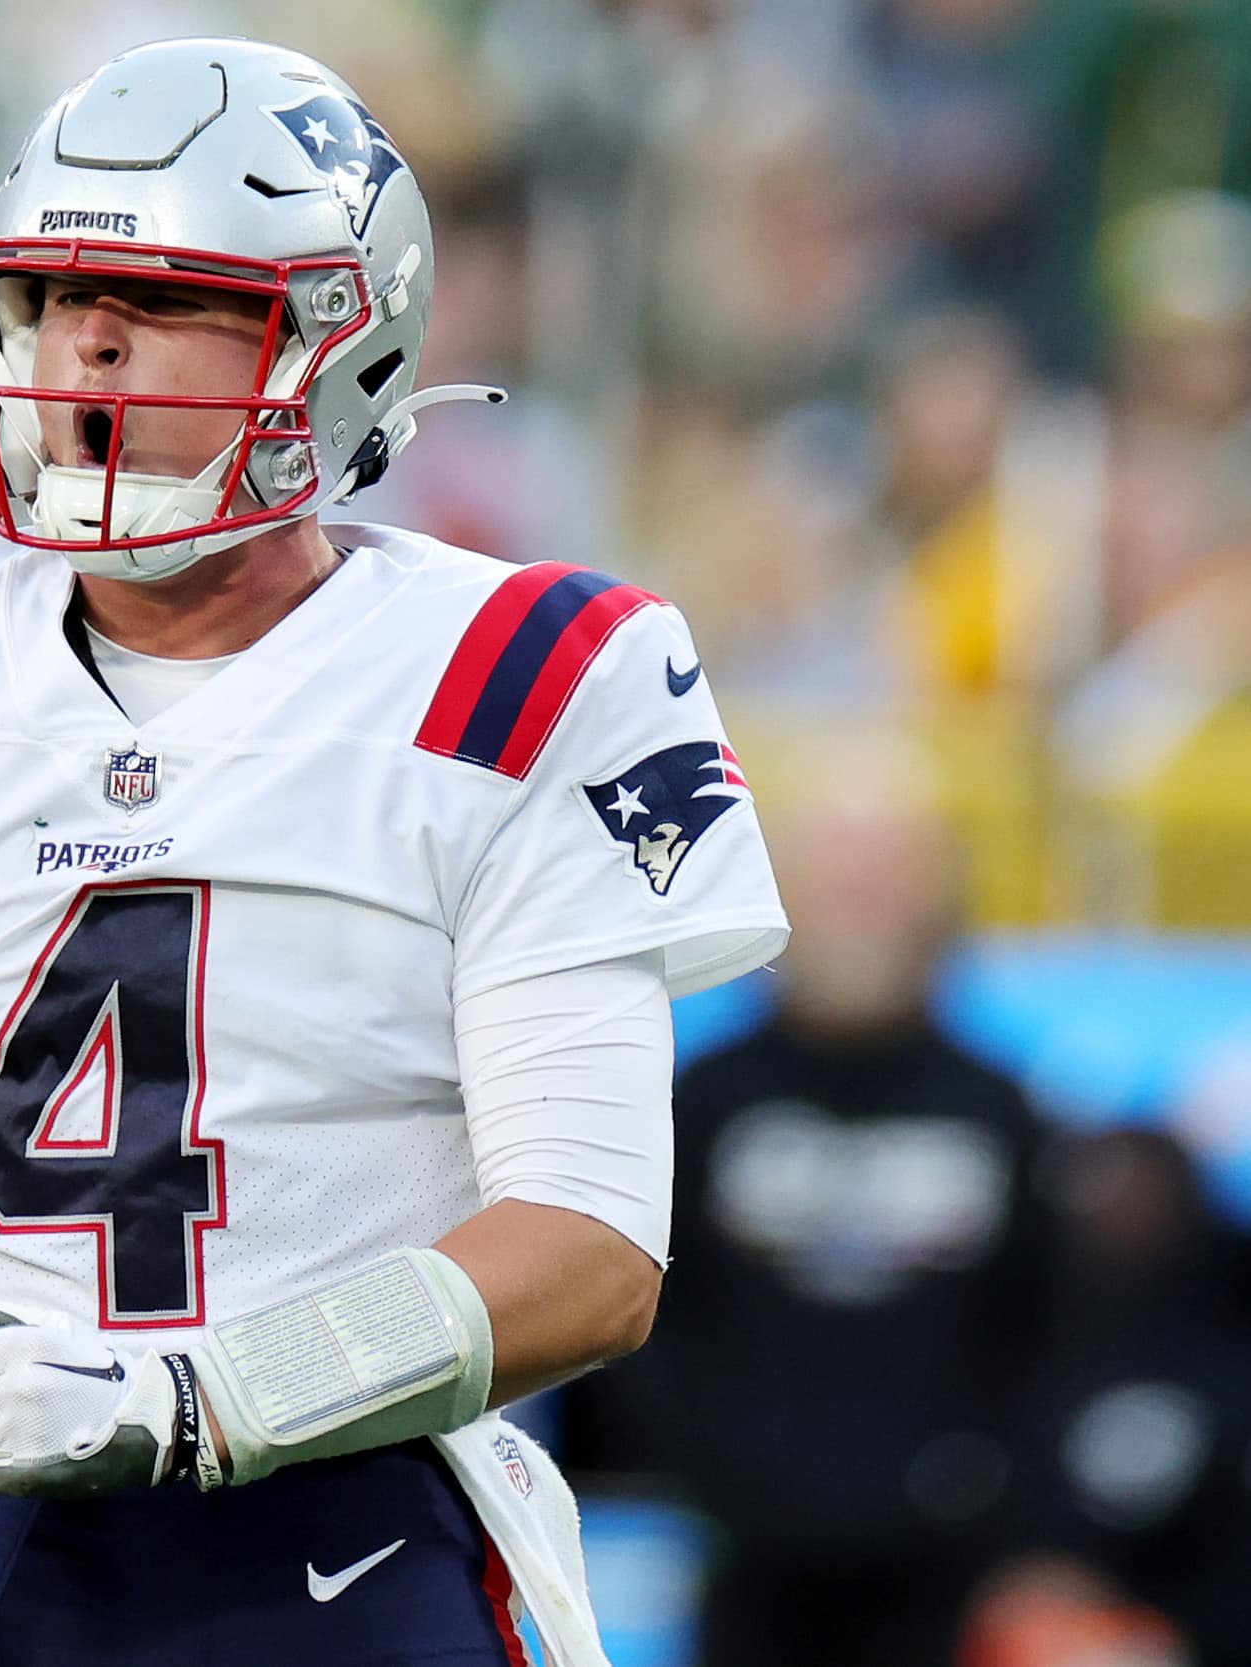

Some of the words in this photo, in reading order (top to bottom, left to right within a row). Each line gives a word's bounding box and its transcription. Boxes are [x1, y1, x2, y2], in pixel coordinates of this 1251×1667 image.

[39, 209, 138, 238] PATRIOTS
[113, 774, 152, 800] NFL
[36, 838, 174, 875] PATRIOTS
[168, 1355, 196, 1426] COUNTRY
